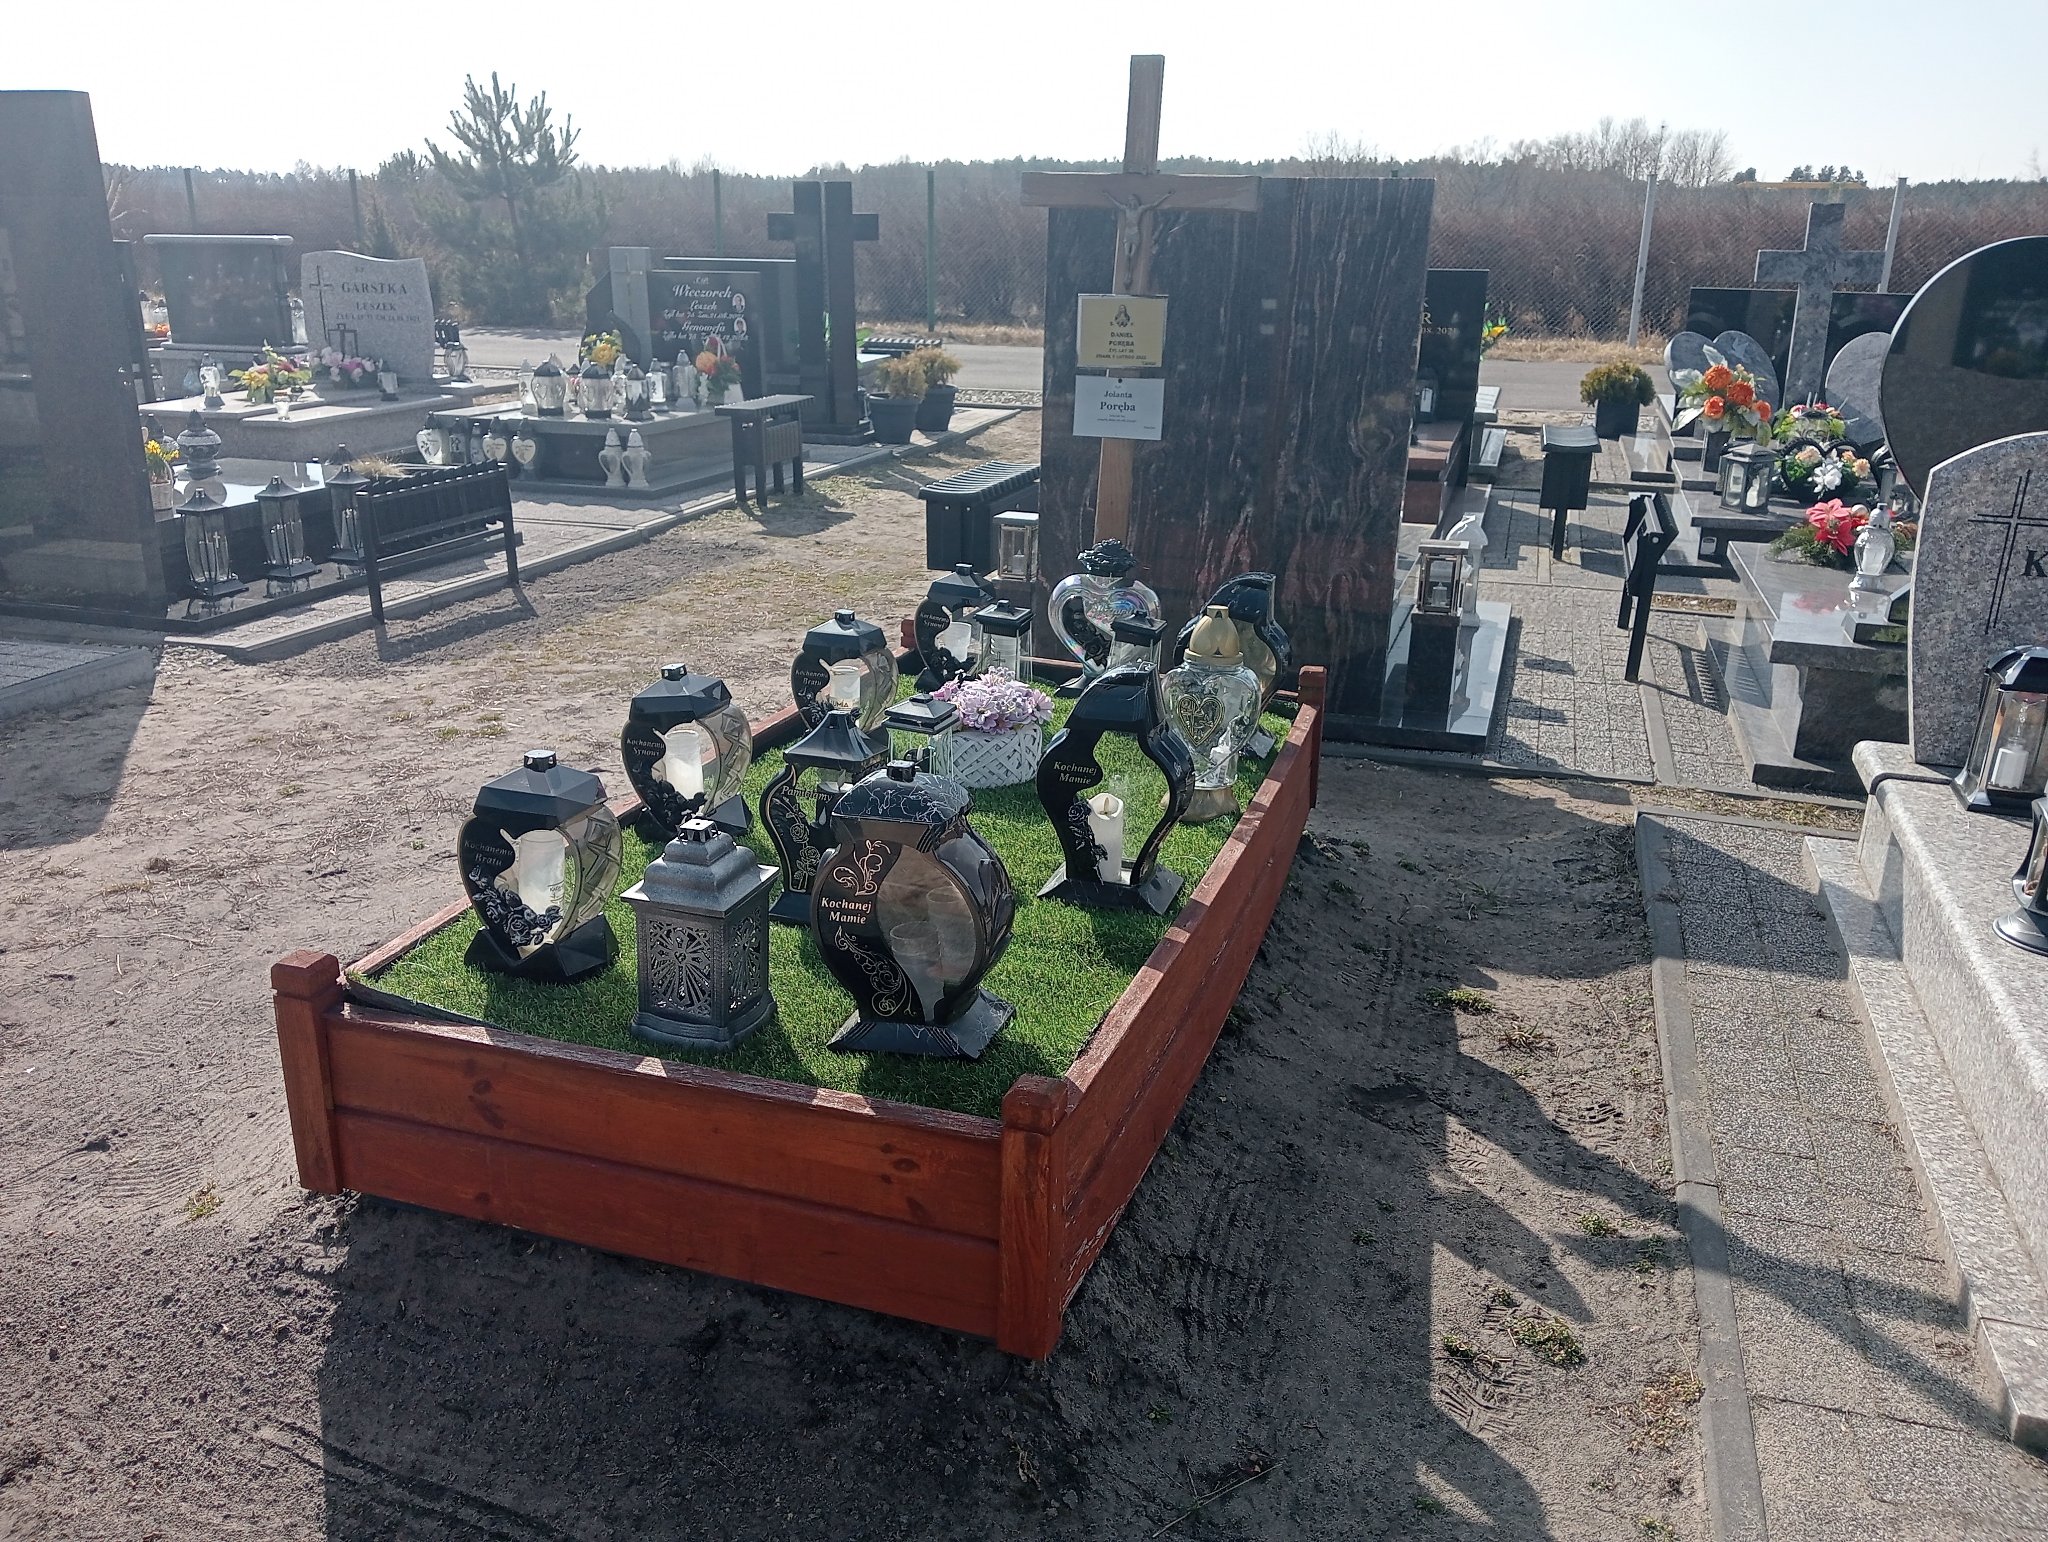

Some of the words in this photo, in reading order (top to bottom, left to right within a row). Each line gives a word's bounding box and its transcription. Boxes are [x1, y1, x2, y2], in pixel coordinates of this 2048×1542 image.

[341, 282, 408, 295] GARSTKA
[356, 301, 397, 312] LESZEK
[1104, 390, 1133, 399] Jolanta
[1099, 401, 1136, 413] Poręba
[1053, 761, 1098, 776] Kochanej
[1059, 772, 1092, 785] Mamie
[820, 897, 872, 914] Kochanej
[828, 911, 867, 925] Mamie
